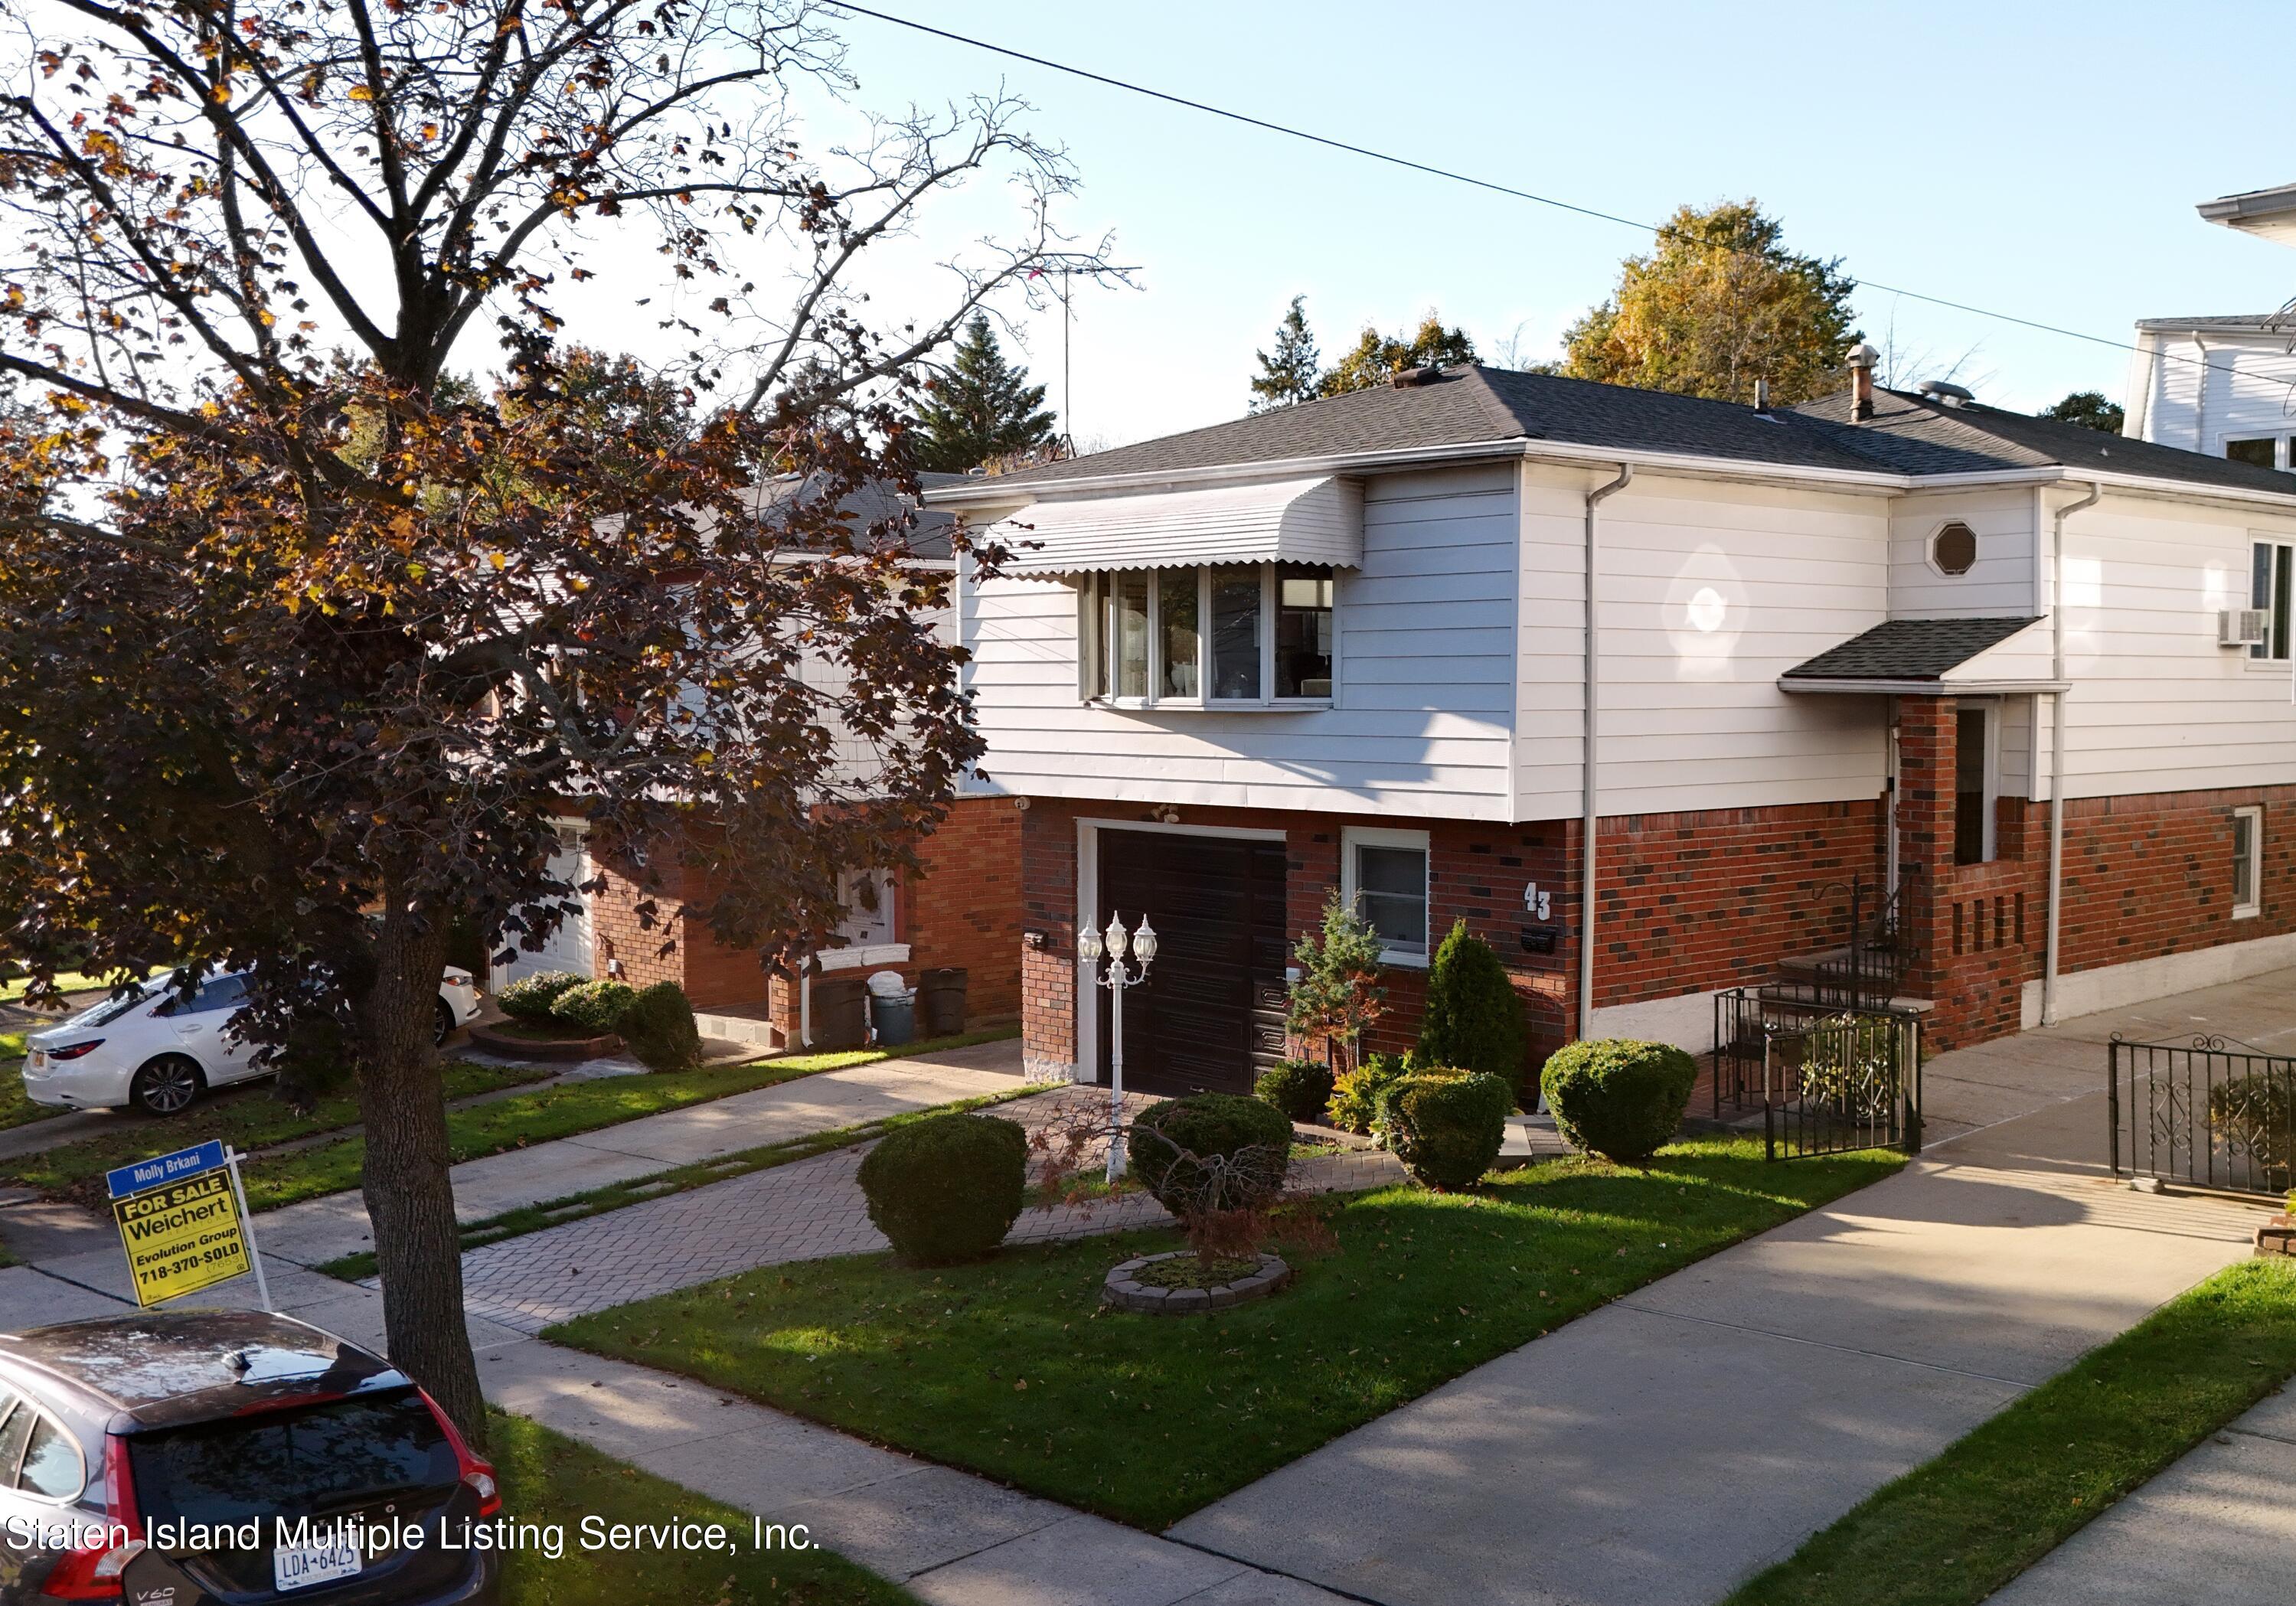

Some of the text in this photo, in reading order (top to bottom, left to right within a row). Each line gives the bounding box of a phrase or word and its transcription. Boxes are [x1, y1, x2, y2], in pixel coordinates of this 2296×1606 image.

[1524, 882, 1550, 921] 43
[134, 1152, 201, 1183] Molly Brkani
[124, 1177, 223, 1219] FOR SALE
[128, 1196, 227, 1241] Weichert
[136, 1227, 237, 1267] Evolution Group
[139, 1242, 240, 1284] 718-370-SOLD
[136, 1587, 175, 1601] V60
